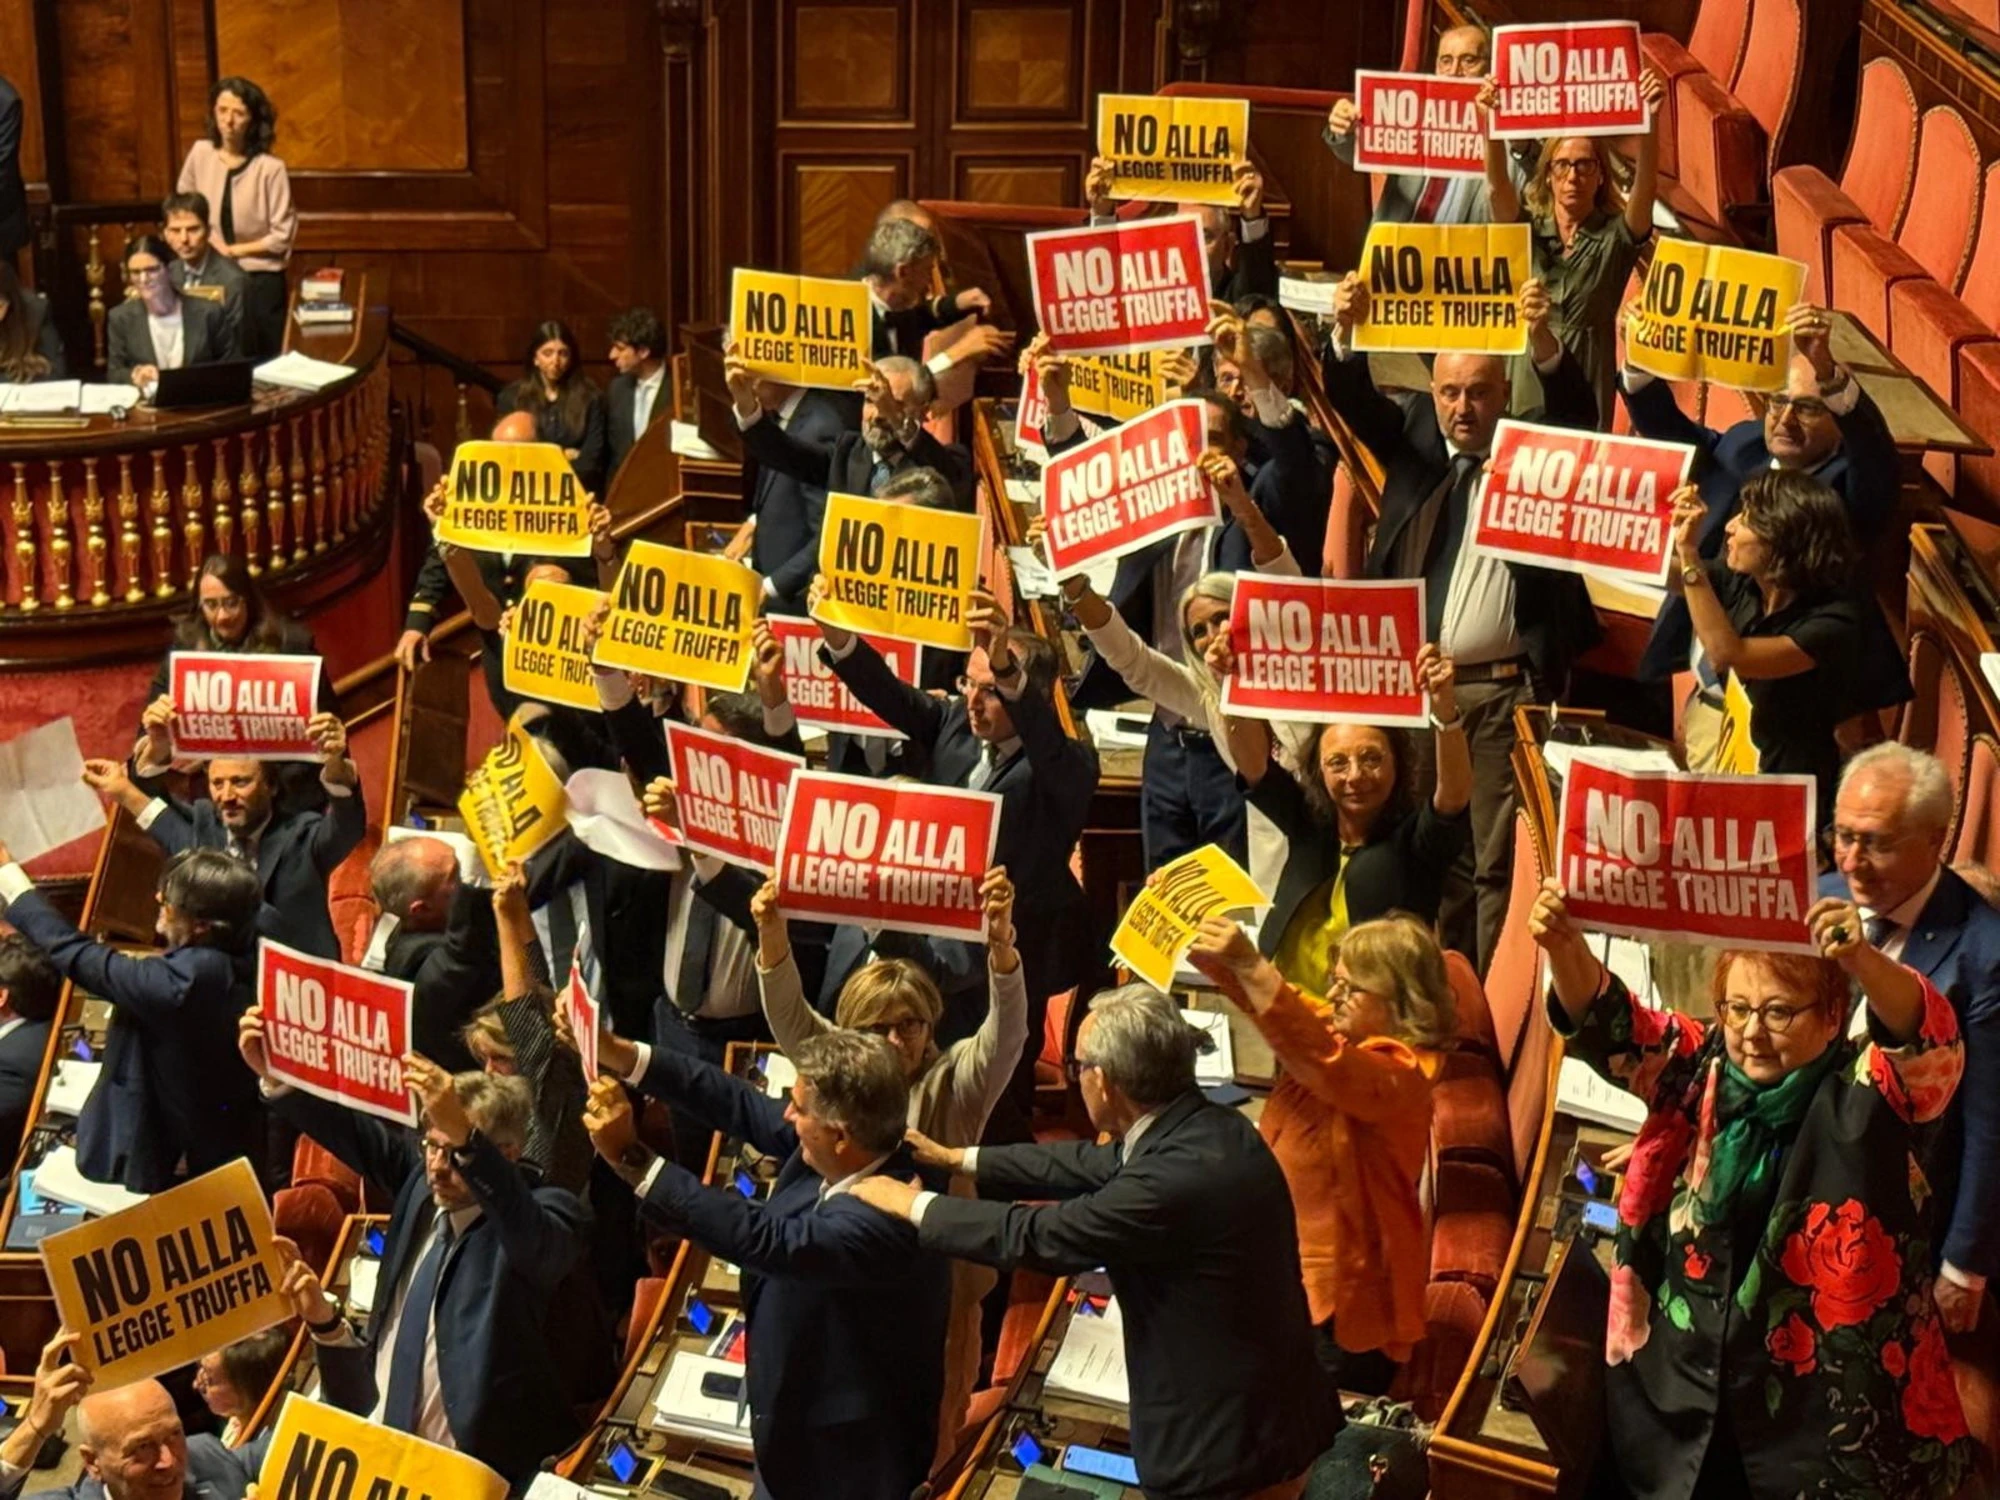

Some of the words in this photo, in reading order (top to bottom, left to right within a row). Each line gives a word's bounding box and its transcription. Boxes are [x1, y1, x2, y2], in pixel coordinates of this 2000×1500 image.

[1508, 42, 1561, 85] NO
[1564, 46, 1628, 81] ALLA
[1373, 88, 1419, 128] NO
[1422, 99, 1479, 132] ALLA
[1499, 86, 1562, 116] LEGGE
[1563, 82, 1638, 113] TRUFFA
[1114, 114, 1158, 157] NO
[1165, 125, 1231, 159] ALLA
[1364, 126, 1418, 155] LEGGE
[1421, 130, 1485, 161] TRUFFA
[1113, 160, 1165, 180] LEGGE
[1171, 162, 1233, 184] TRUFFA
[1053, 247, 1115, 300] NO
[1120, 247, 1188, 293] ALLA
[1370, 245, 1424, 294] NO
[1434, 256, 1514, 296] ALLA
[1645, 260, 1684, 317] NO
[1689, 278, 1778, 330] ALLA
[746, 290, 788, 335] NO
[795, 304, 857, 343] ALLA
[1048, 296, 1121, 335] LEGGE
[1120, 287, 1203, 329] TRUFFA
[1371, 299, 1435, 327] LEGGE
[1441, 301, 1517, 329] TRUFFA
[744, 338, 795, 364] LEGGE
[799, 342, 859, 370] TRUFFA
[1694, 328, 1774, 365] TRUFFA
[1069, 362, 1100, 393] EGGE
[1104, 371, 1155, 408] TRUFFA
[455, 460, 501, 503] NO
[508, 471, 577, 507] ALLA
[1060, 452, 1114, 513] NO
[1117, 430, 1191, 490] ALLA
[1507, 445, 1577, 499] NO
[1574, 463, 1656, 515] ALLA
[453, 507, 508, 532] LEGGE
[513, 510, 579, 536] TRUFFA
[1051, 494, 1122, 550] LEGGE
[1120, 467, 1207, 527] TRUFFA
[1486, 492, 1568, 540] LEGGE
[1571, 504, 1661, 555] TRUFFA
[835, 519, 885, 575] NO
[890, 537, 959, 589] ALLA
[518, 598, 555, 646] NO
[618, 561, 666, 617] NO
[672, 582, 742, 634] ALLA
[834, 576, 888, 611] LEGGE
[896, 587, 960, 624] TRUFFA
[611, 616, 669, 651] LEGGE
[673, 628, 740, 667] TRUFFA
[1248, 598, 1313, 653] NO
[1320, 613, 1401, 658] ALLA
[514, 647, 556, 677] LEGGE
[1238, 653, 1317, 690] LEGGE
[1321, 659, 1417, 697] TRUFFA
[184, 670, 233, 713] NO
[236, 680, 298, 715] ALLA
[786, 677, 835, 709] EGGE
[178, 714, 237, 740] LEGGE
[685, 747, 734, 805] NO
[683, 793, 740, 841] LEGGE
[808, 798, 881, 860] NO
[880, 819, 966, 873] ALLA
[1584, 787, 1661, 868] NO
[1671, 816, 1781, 874] ALLA
[788, 853, 871, 900] LEGGE
[876, 864, 975, 911] TRUFFA
[1568, 852, 1667, 909] LEGGE
[1677, 870, 1801, 922] TRUFFA
[274, 968, 326, 1034] NO
[332, 995, 391, 1053] ALLA
[267, 1019, 330, 1071] LEGGE
[332, 1039, 404, 1095] TRUFFA
[71, 1237, 151, 1322] NO
[156, 1205, 259, 1293] ALLA
[91, 1307, 176, 1367] LEGGE
[180, 1261, 273, 1330] TRUFFA
[277, 1432, 359, 1500] NO
